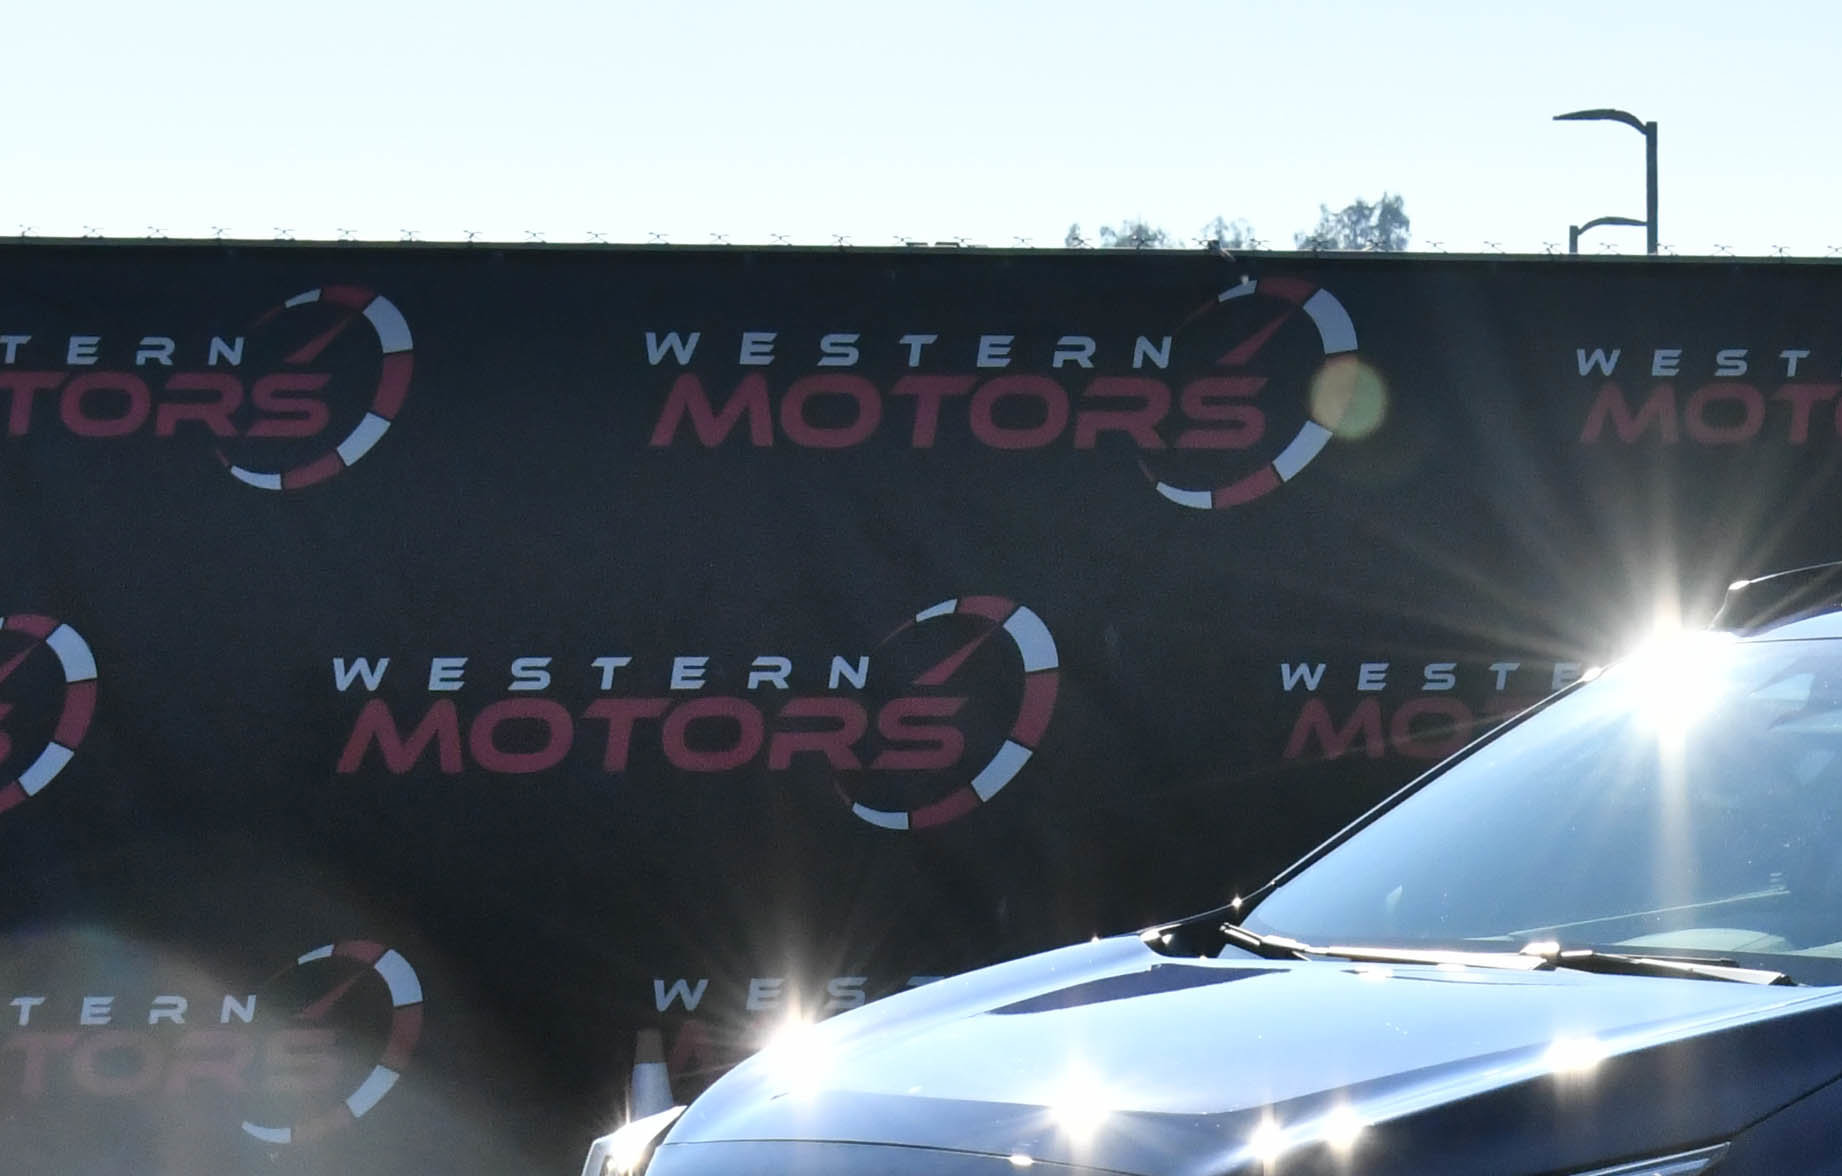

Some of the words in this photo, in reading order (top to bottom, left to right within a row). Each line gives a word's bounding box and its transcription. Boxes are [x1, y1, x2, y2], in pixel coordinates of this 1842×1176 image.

[645, 332, 1173, 369] WESTERN
[650, 373, 1267, 450] MOTORS
[332, 655, 870, 692] WESTERN
[337, 695, 968, 774] MOTORS
